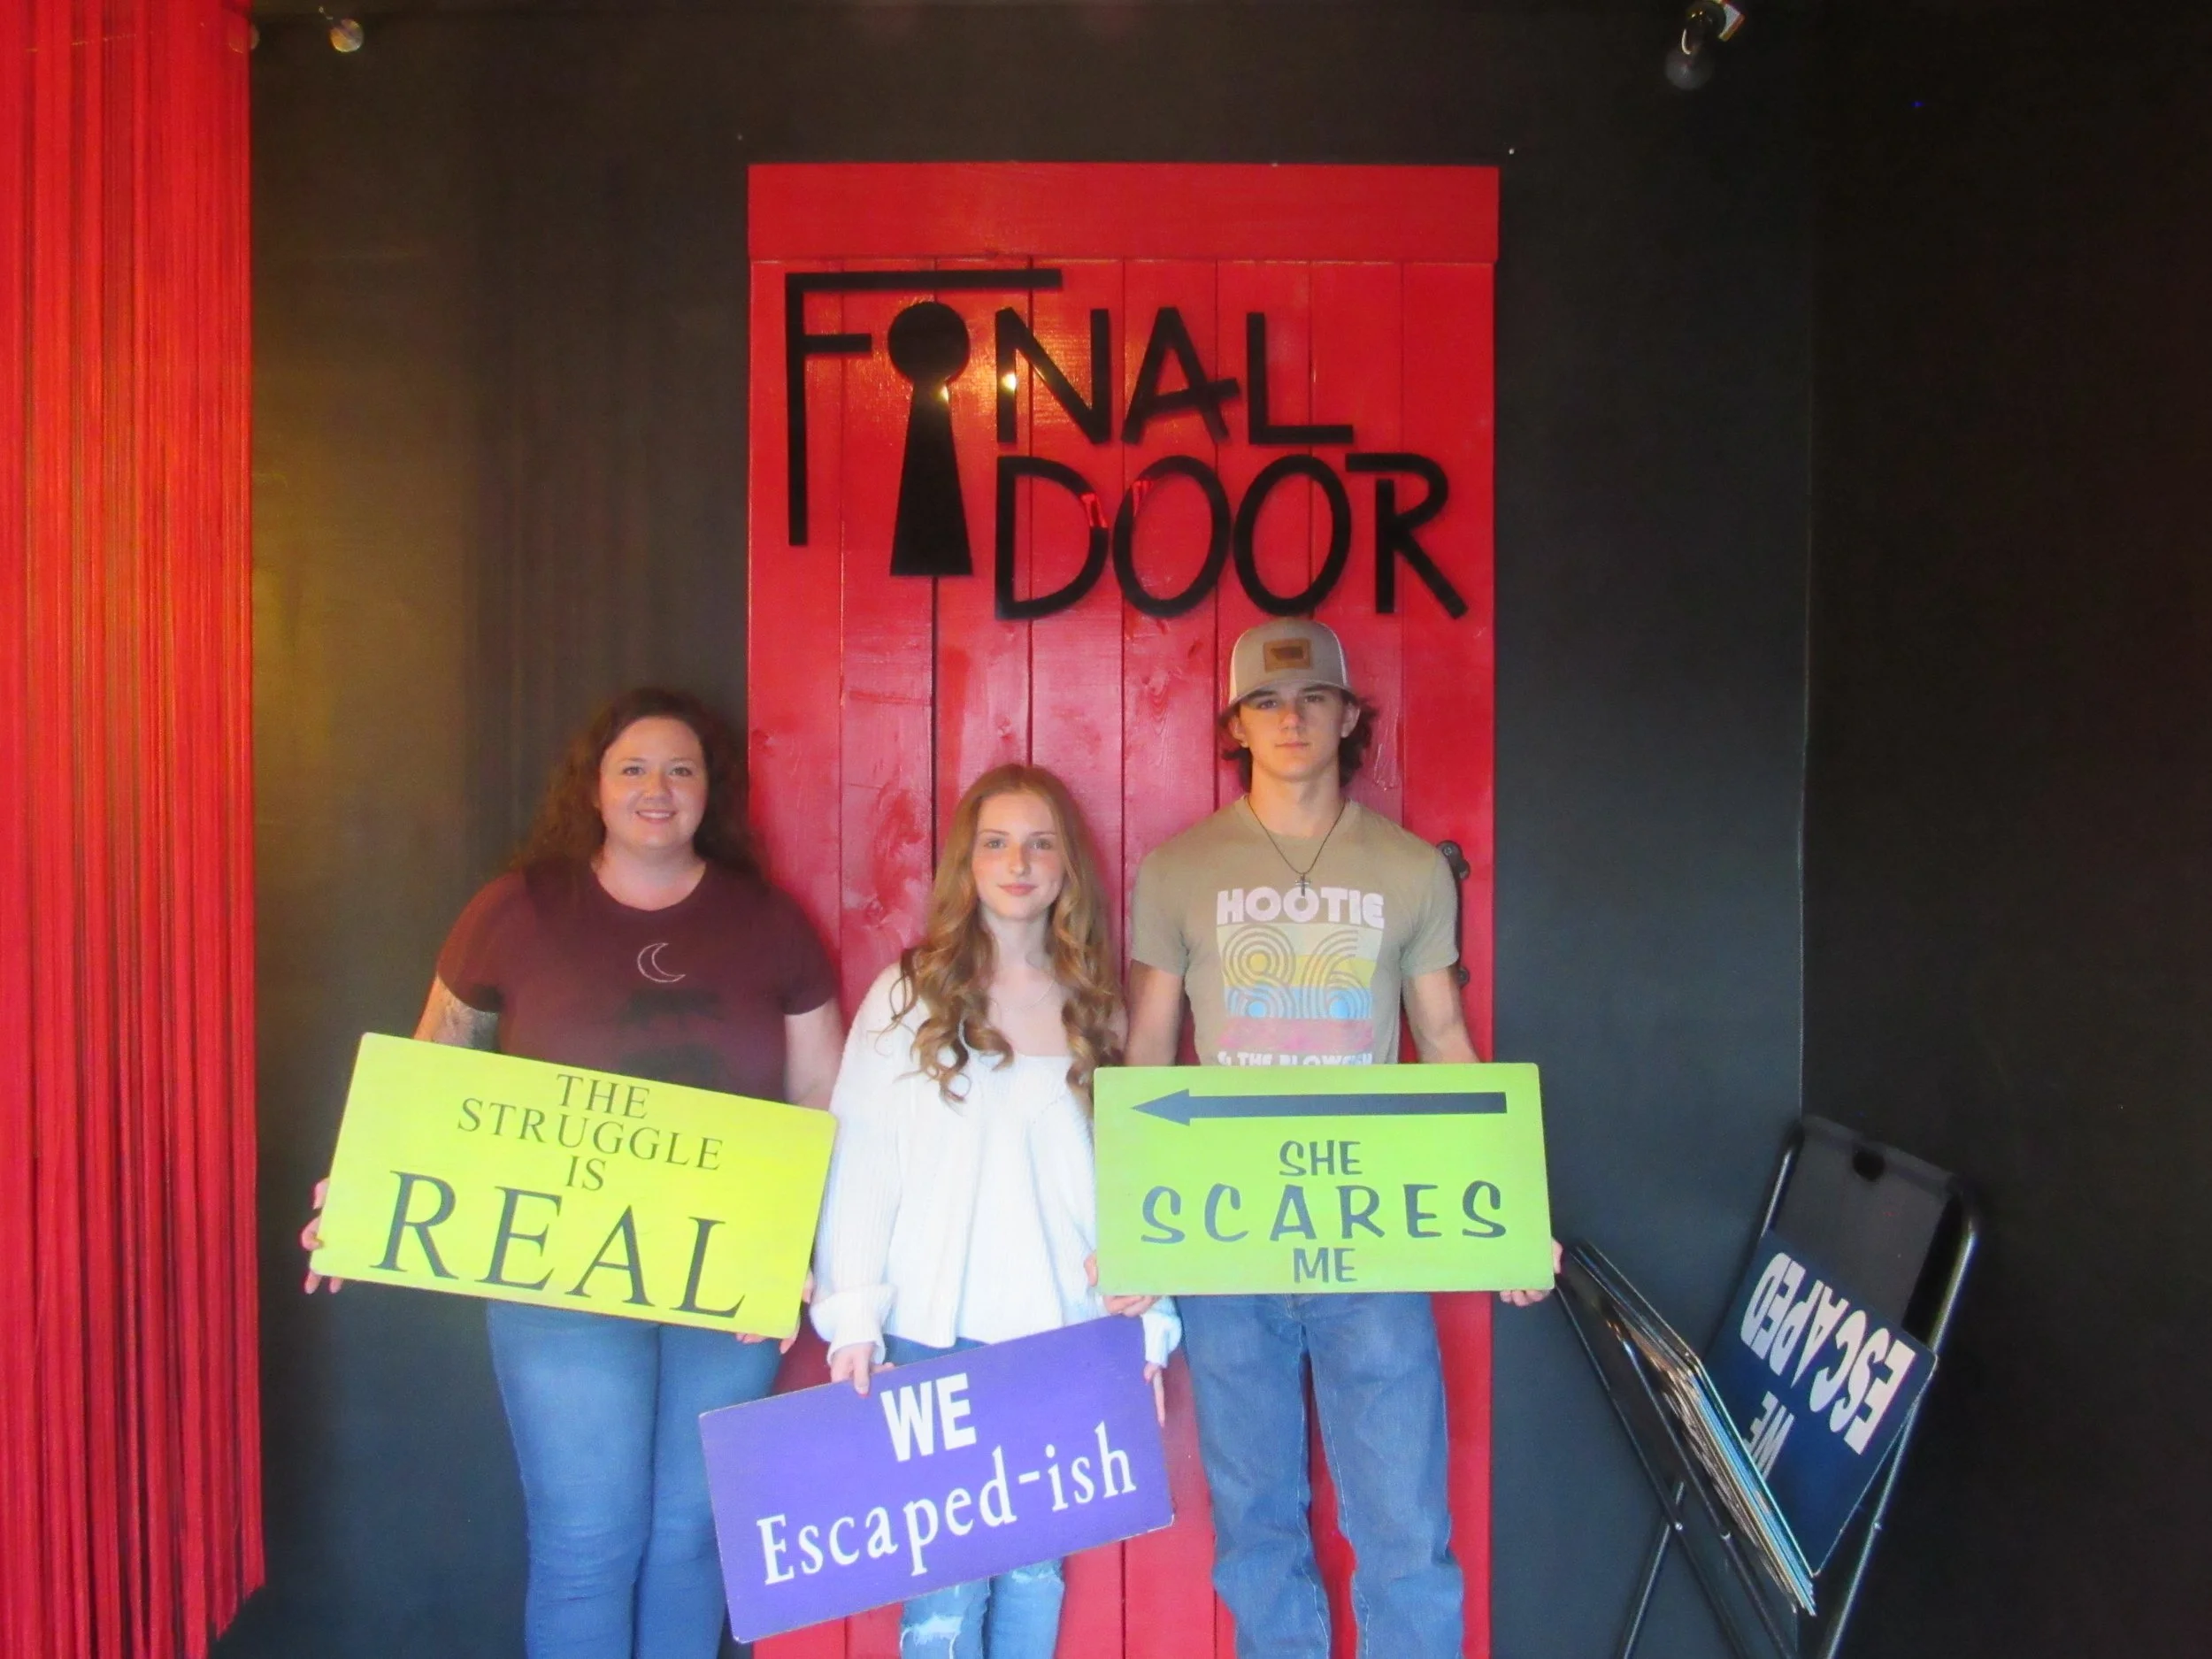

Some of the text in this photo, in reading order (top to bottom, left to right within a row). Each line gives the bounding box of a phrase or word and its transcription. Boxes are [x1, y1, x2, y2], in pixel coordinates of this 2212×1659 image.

[995, 451, 1468, 620] DOOR
[1217, 887, 1385, 929] HOOTIE
[557, 1073, 650, 1119] THE
[457, 1097, 724, 1172] STRUGGLE
[1279, 1139, 1363, 1178] SHE
[565, 1155, 607, 1192] IS
[368, 1170, 747, 1319] REAL
[1141, 1180, 1507, 1244] SCARES
[1293, 1248, 1359, 1284] ME
[1740, 1252, 1917, 1455] ESCAPED
[879, 1372, 978, 1463] WE
[756, 1421, 1138, 1586] Escaped-ish
